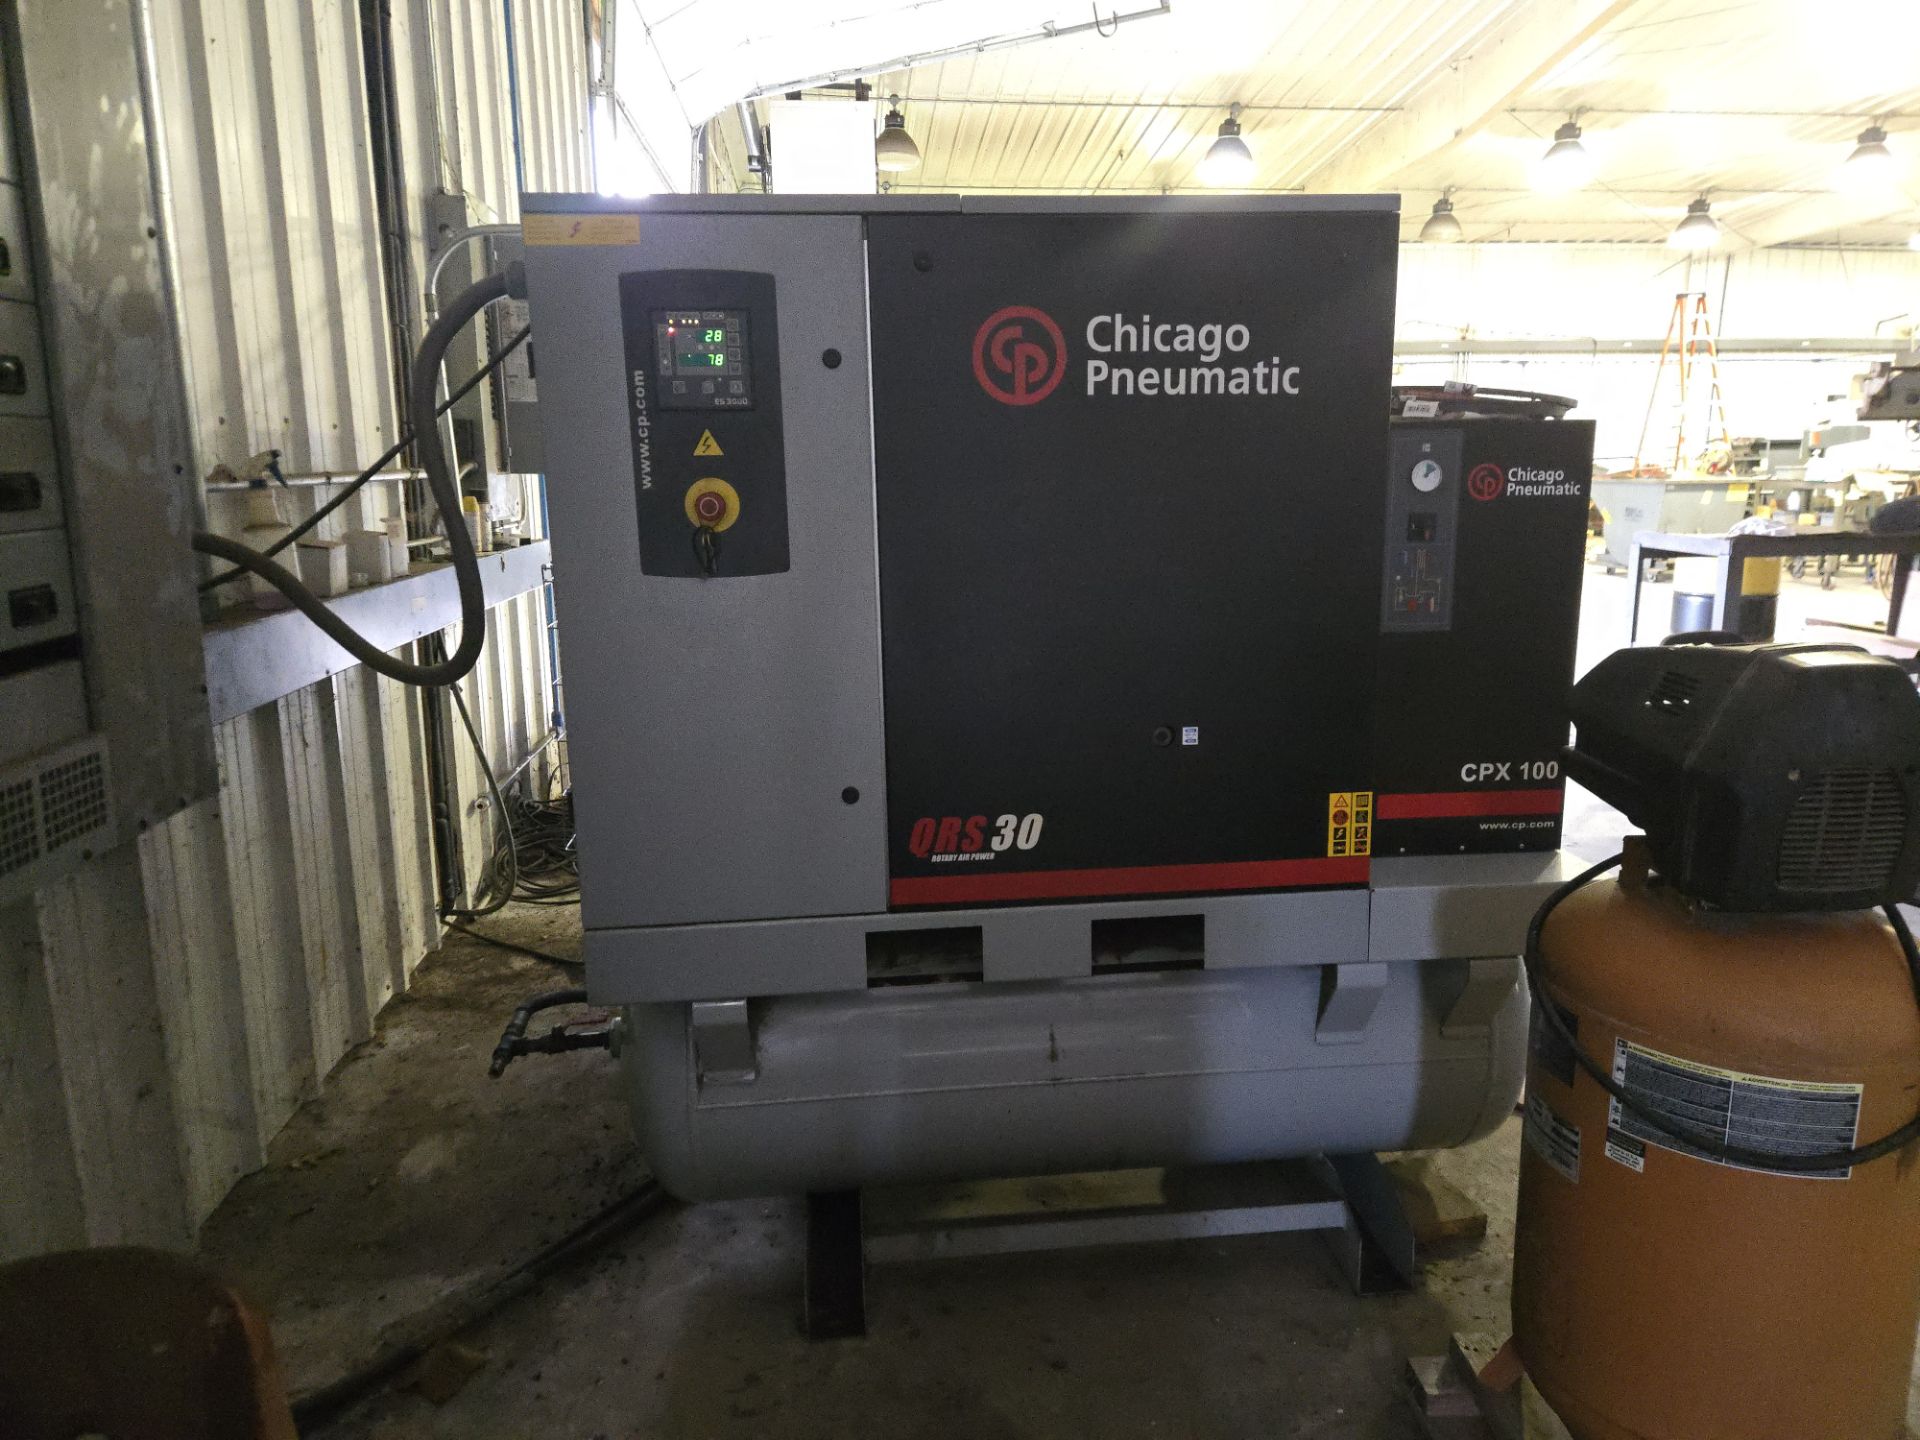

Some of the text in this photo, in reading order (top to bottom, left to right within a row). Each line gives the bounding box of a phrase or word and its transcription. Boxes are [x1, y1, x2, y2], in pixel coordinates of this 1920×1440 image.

[704, 329, 722, 342] 28
[1086, 313, 1250, 362] Chicago
[707, 353, 724, 366] 78
[1087, 356, 1300, 396] Pneumatic
[634, 369, 652, 490] www.cp.com
[1508, 467, 1565, 485] Chicago
[1506, 481, 1581, 497] Pneumatic
[1461, 761, 1559, 782] CPX 100
[990, 812, 1044, 852] 30
[1479, 820, 1556, 831] www.cp.com
[957, 853, 970, 862] AIR
[970, 852, 995, 861] POWER
